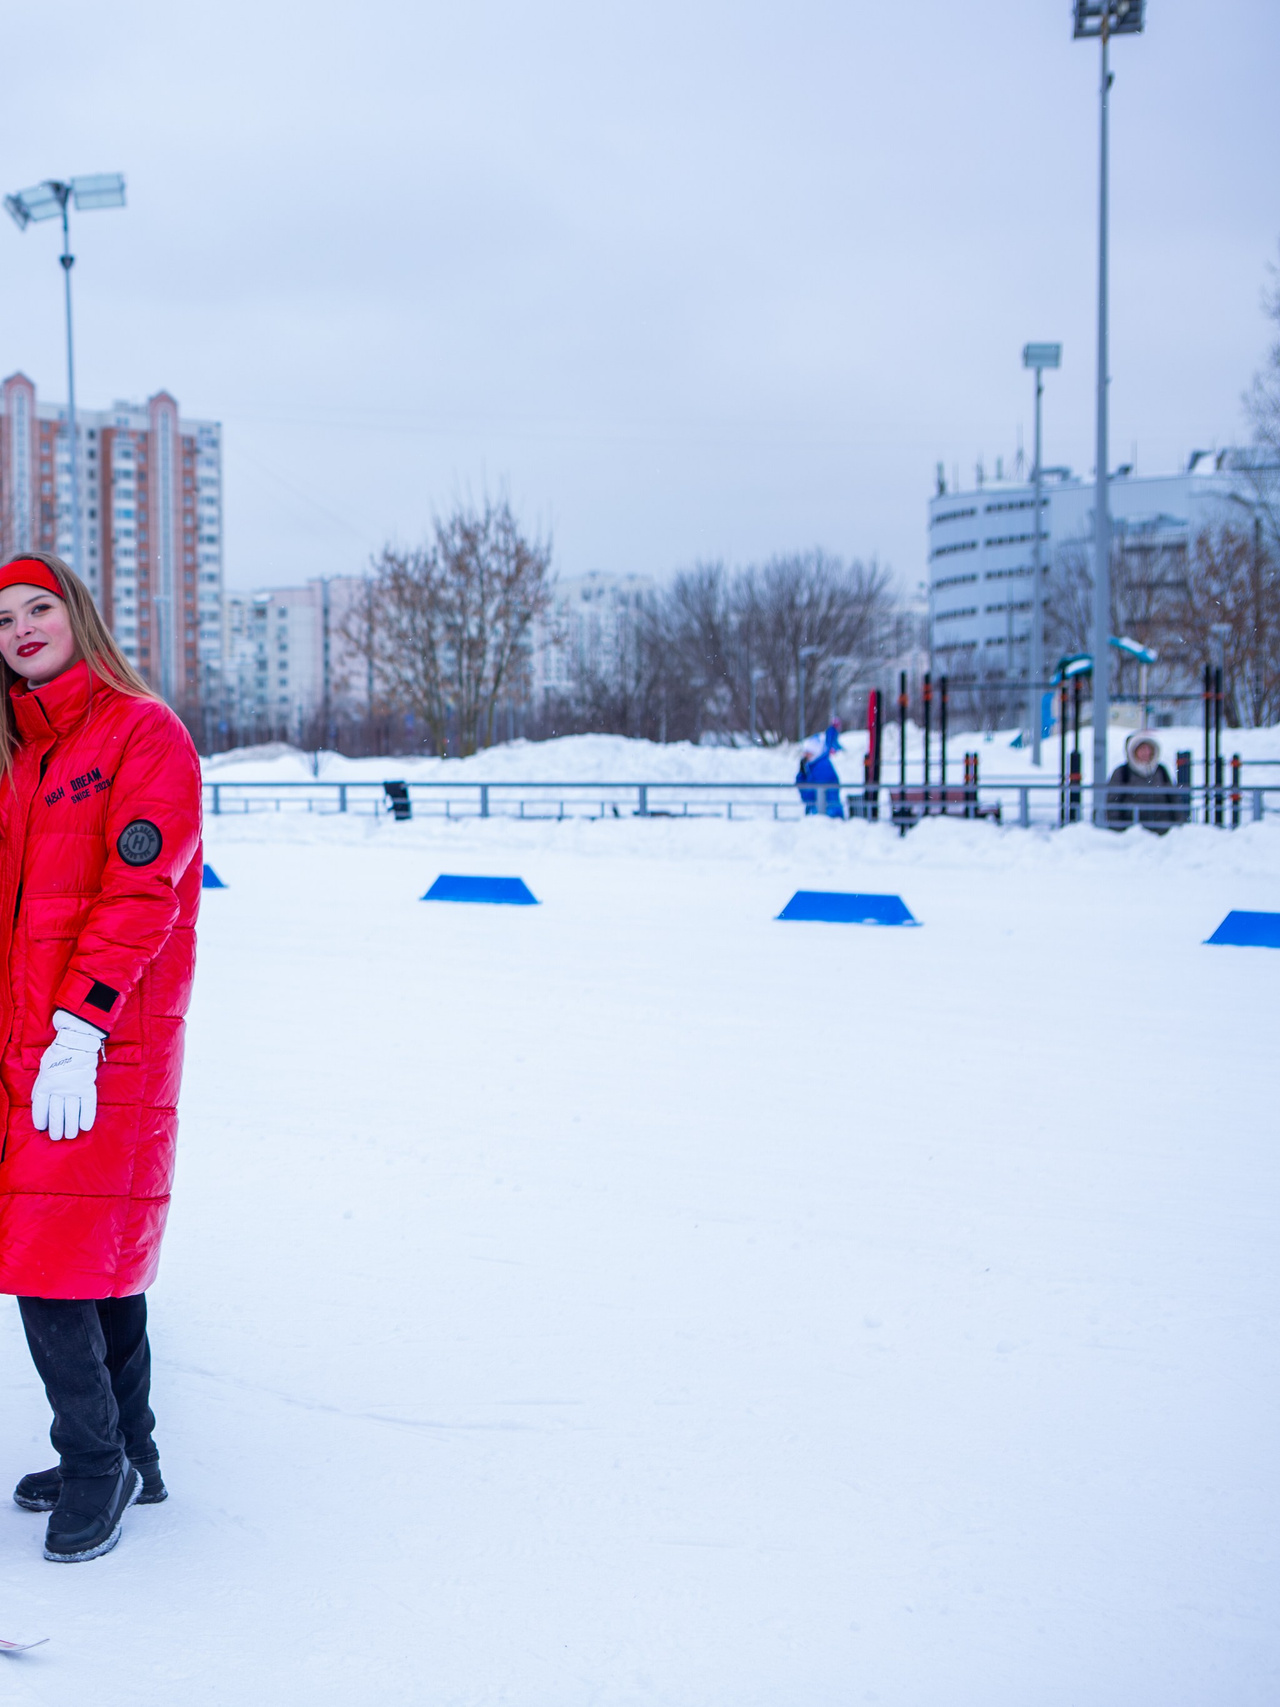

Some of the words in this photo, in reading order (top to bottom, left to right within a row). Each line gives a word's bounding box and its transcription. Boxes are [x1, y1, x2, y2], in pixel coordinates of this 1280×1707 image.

[44, 786, 66, 808] H&H
[70, 767, 102, 791] DREAM
[132, 834, 145, 851] H
